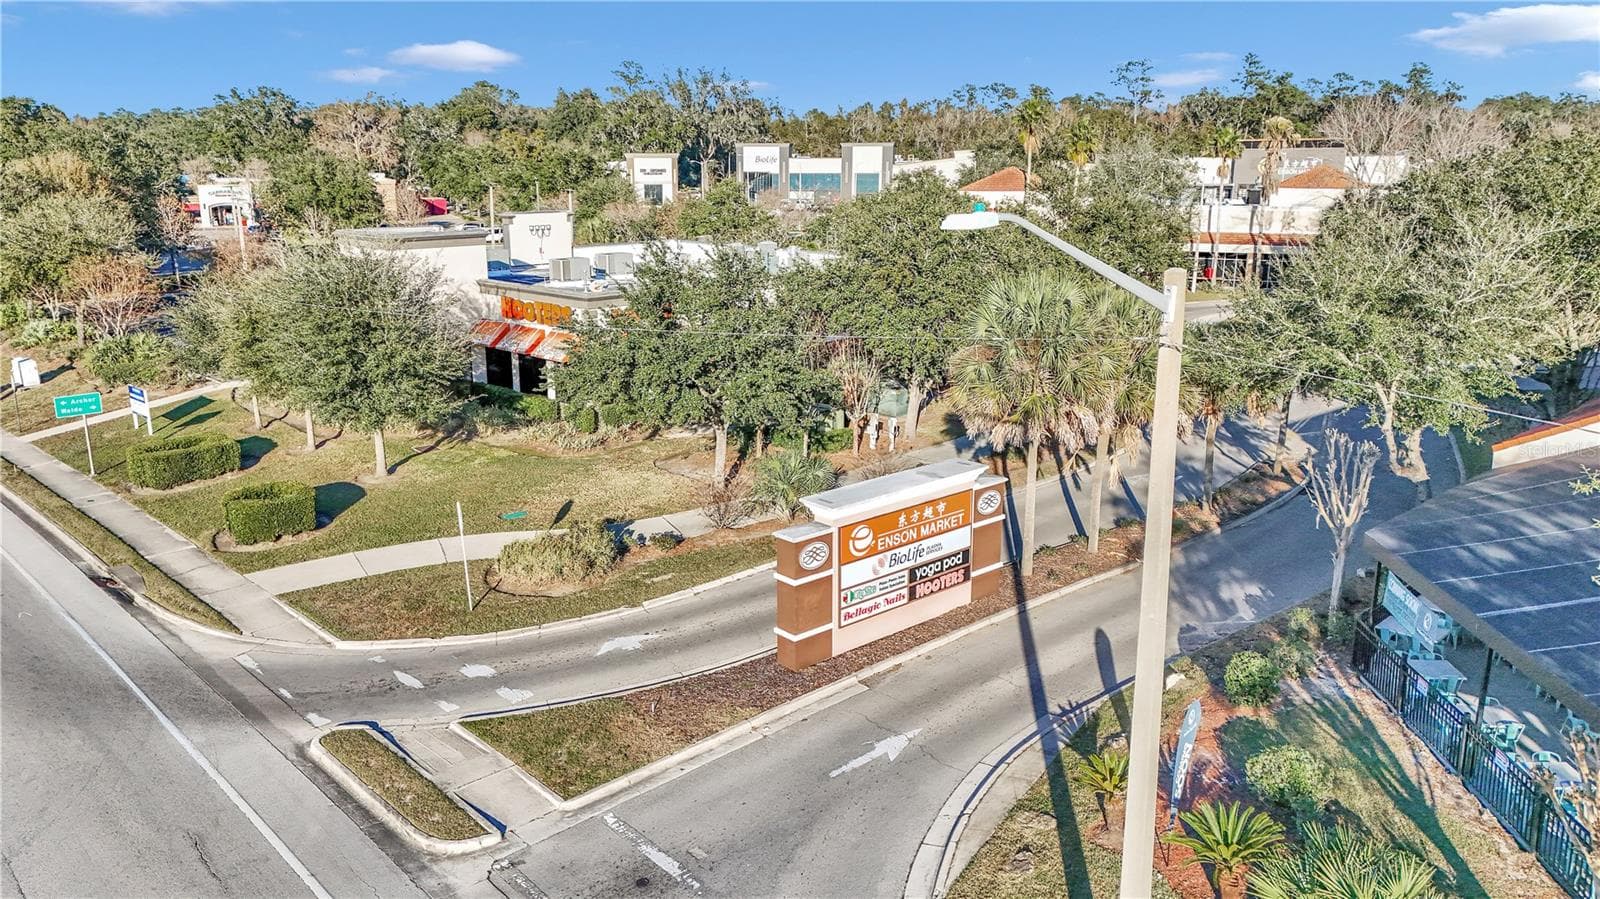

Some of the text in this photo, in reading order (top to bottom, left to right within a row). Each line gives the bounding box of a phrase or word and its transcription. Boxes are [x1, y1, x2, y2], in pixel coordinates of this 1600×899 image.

[71, 397, 97, 405] Archer
[898, 502, 947, 527] 东方超市
[877, 513, 965, 550] ENSON MARKET
[889, 544, 925, 568] BioLife
[915, 562, 942, 580] yoga
[942, 554, 963, 572] pod
[916, 569, 965, 598] HOOTERS
[884, 593, 906, 607] Nails
